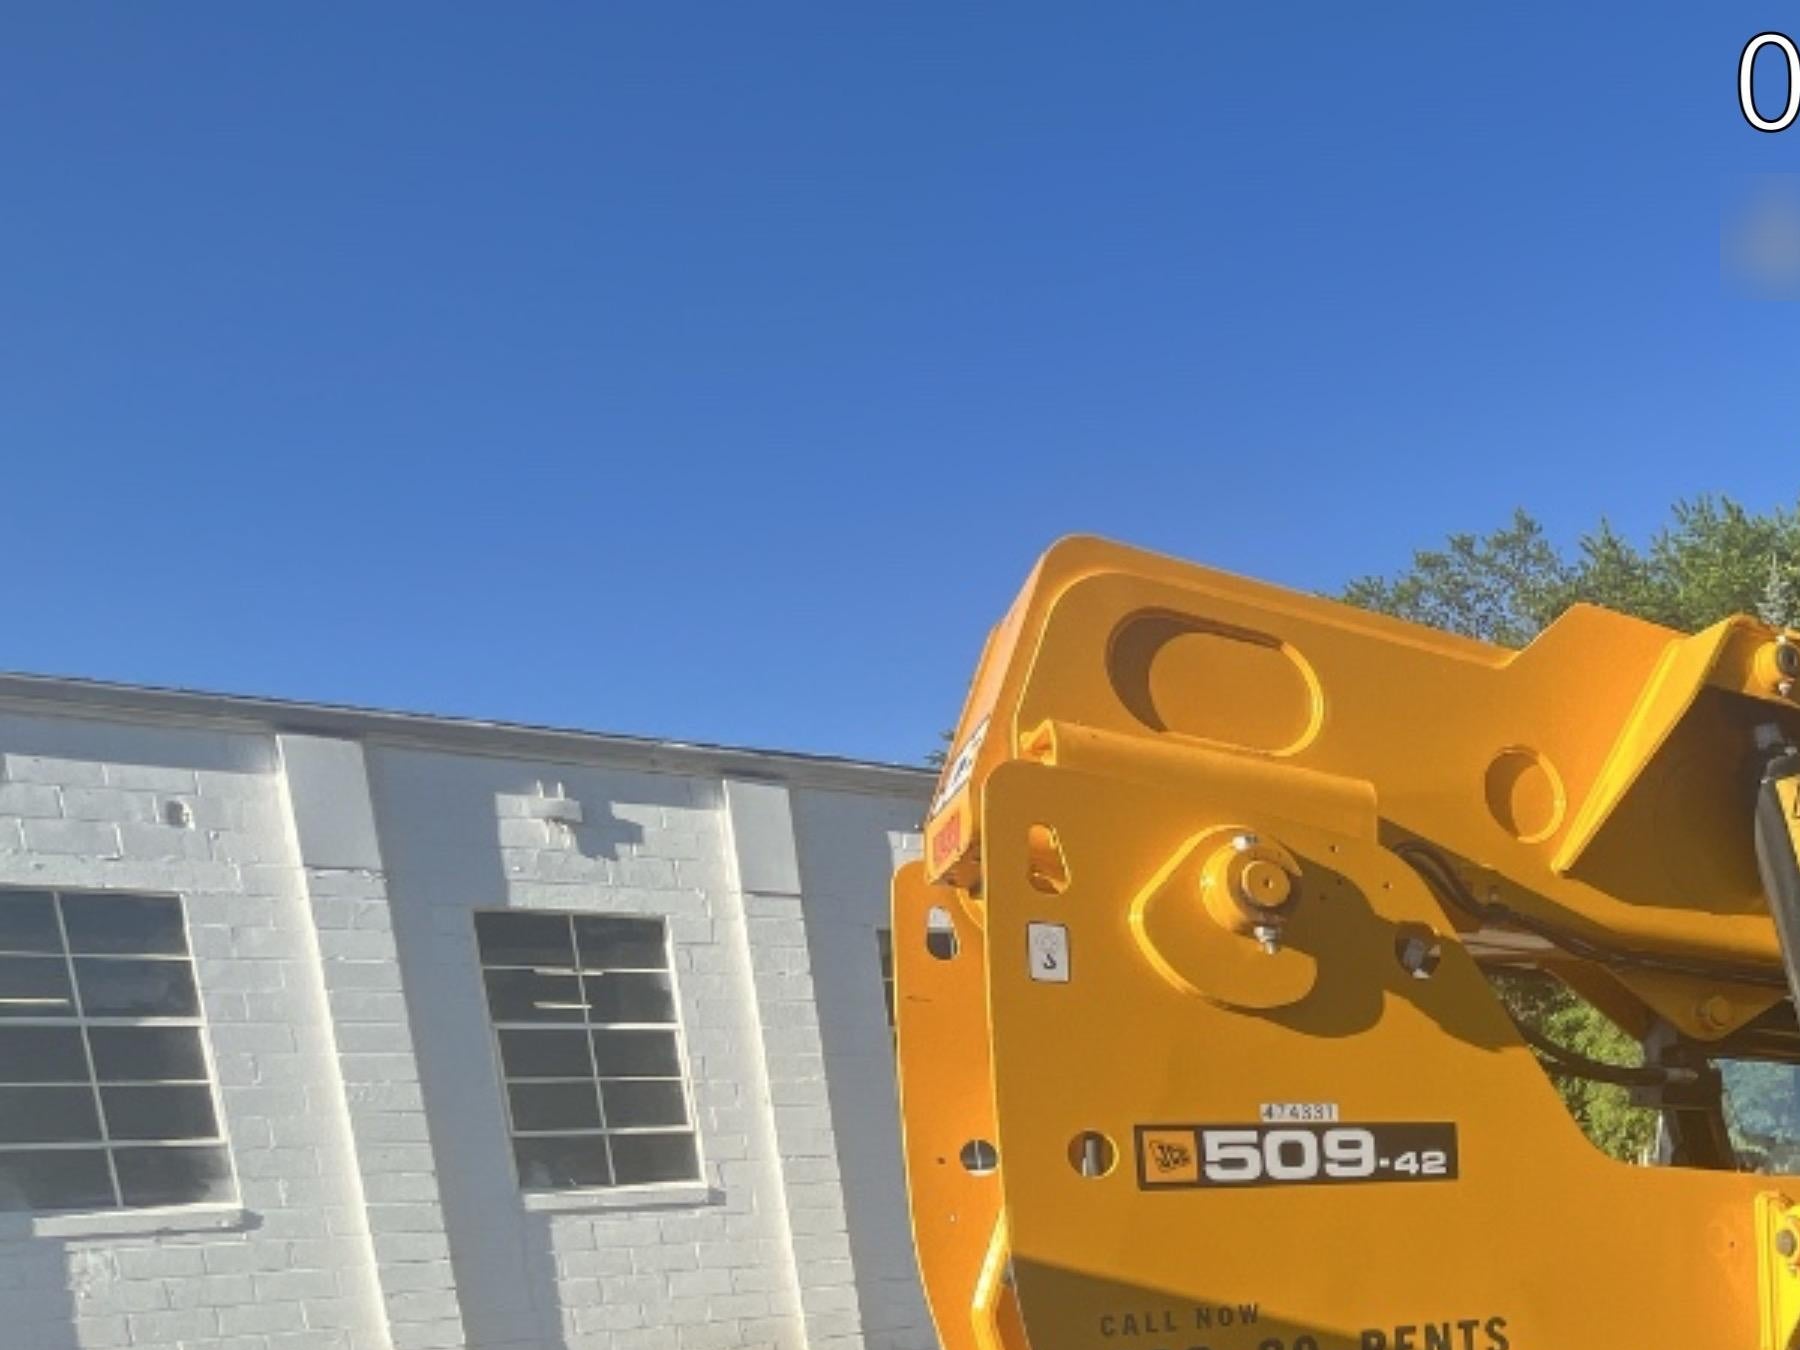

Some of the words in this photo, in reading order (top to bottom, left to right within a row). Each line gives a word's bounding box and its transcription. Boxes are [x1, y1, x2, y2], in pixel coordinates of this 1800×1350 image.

[1202, 1128, 1447, 1181] 509-42
[1101, 1312, 1177, 1337] CALL
[1196, 1303, 1259, 1329] NOW
